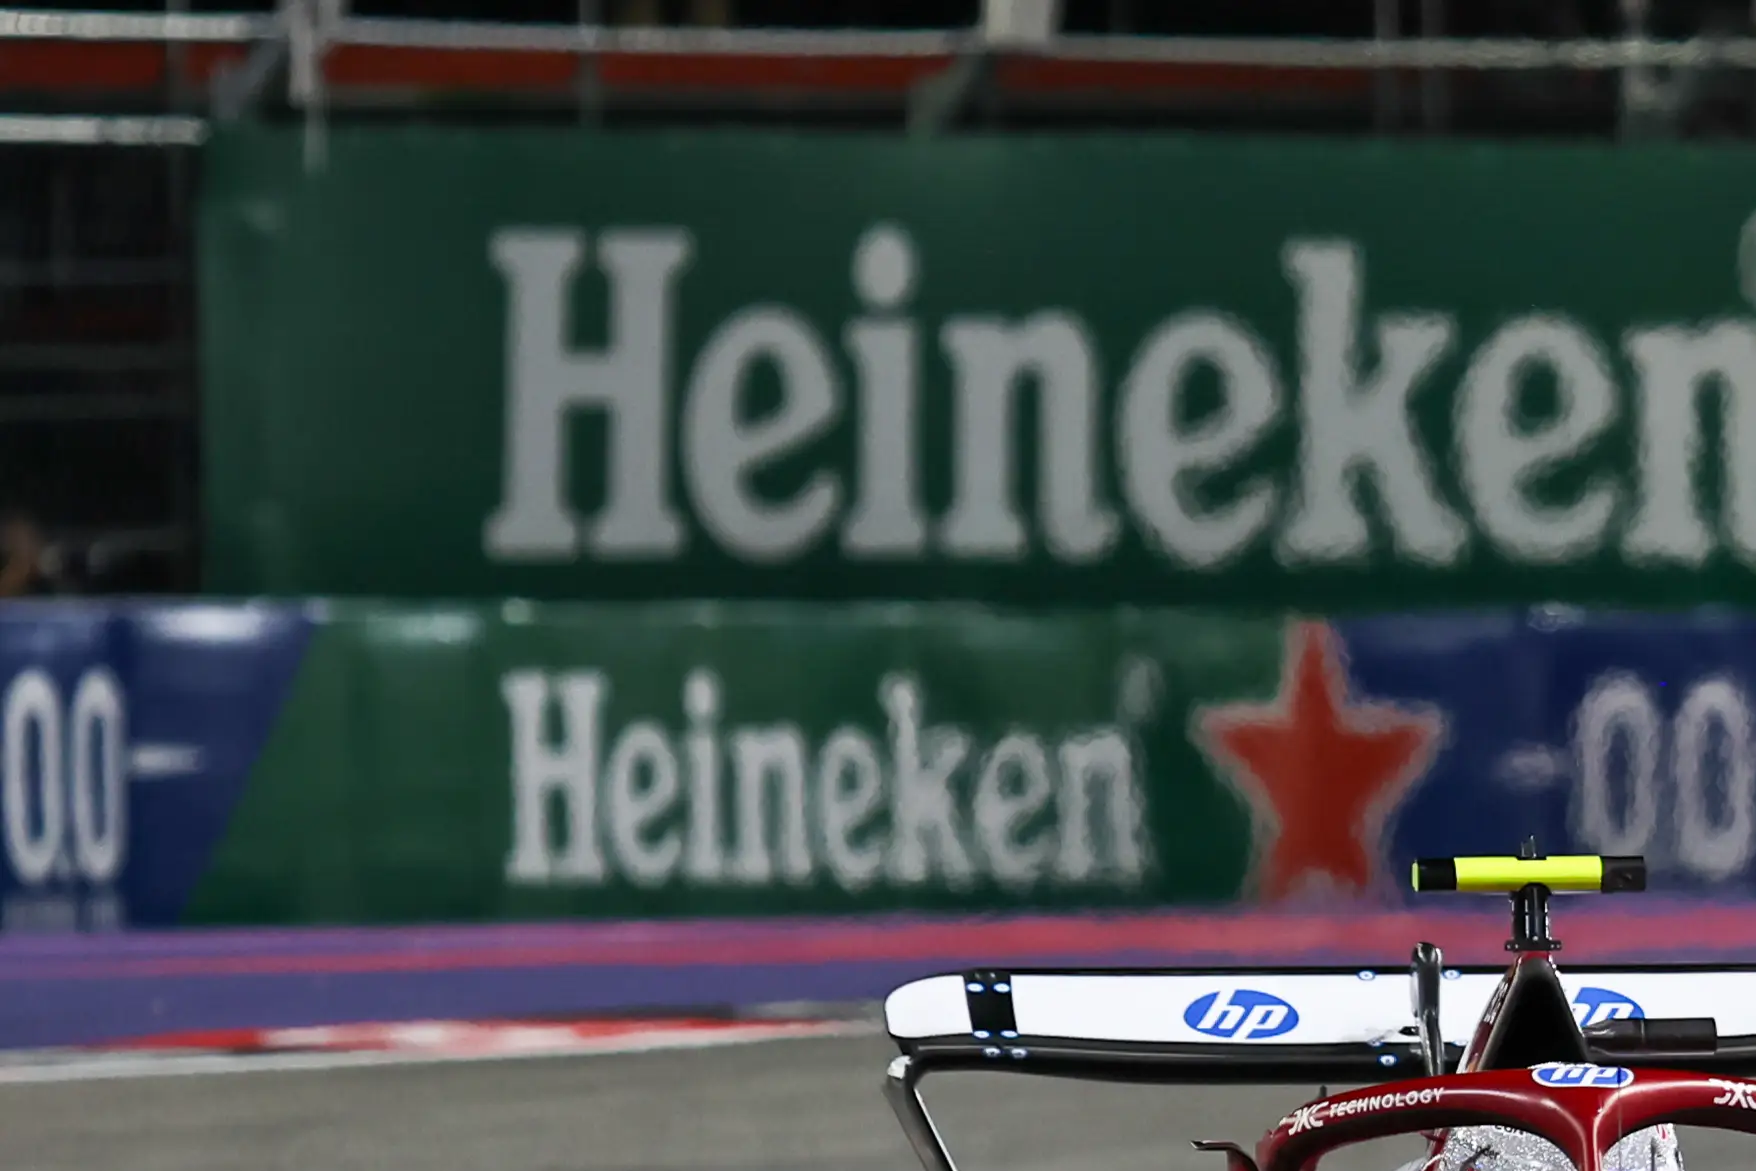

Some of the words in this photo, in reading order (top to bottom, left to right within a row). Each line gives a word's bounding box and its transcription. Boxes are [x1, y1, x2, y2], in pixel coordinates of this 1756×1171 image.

[502, 667, 1150, 890] Heineken
[1194, 988, 1291, 1039] hp
[1329, 1087, 1445, 1118] TECHNOLOGY
